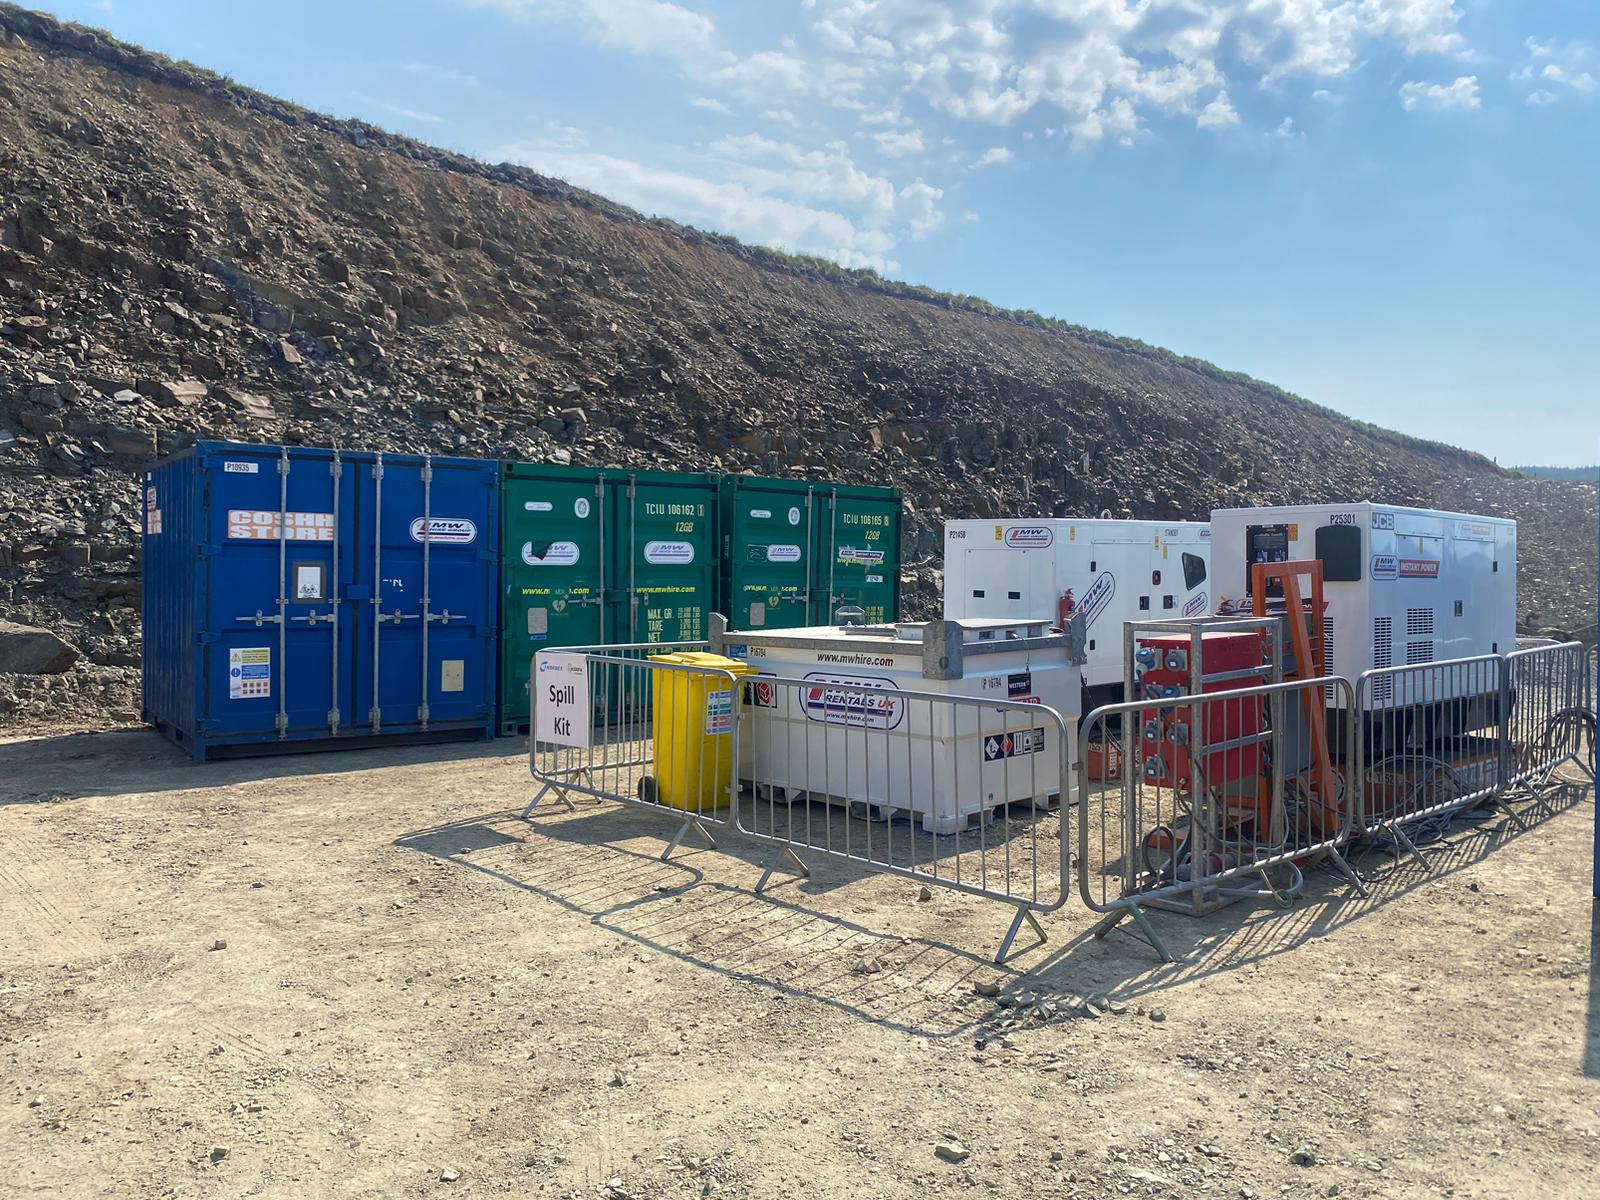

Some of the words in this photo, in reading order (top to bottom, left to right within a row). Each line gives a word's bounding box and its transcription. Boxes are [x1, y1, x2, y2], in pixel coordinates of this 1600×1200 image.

[226, 462, 250, 472] P10935
[645, 503, 665, 515] TCIU
[667, 504, 695, 516] 106162
[230, 511, 335, 527] COSHH
[843, 513, 859, 525] TCIU
[1330, 514, 1356, 525] P25301
[1372, 512, 1394, 530] JCB
[229, 525, 334, 540] STORE
[816, 653, 894, 667] www.mwhire.com
[549, 684, 575, 708] Spill
[825, 694, 876, 708] RENTALS
[877, 700, 897, 710] UK
[554, 716, 571, 737] Kit
